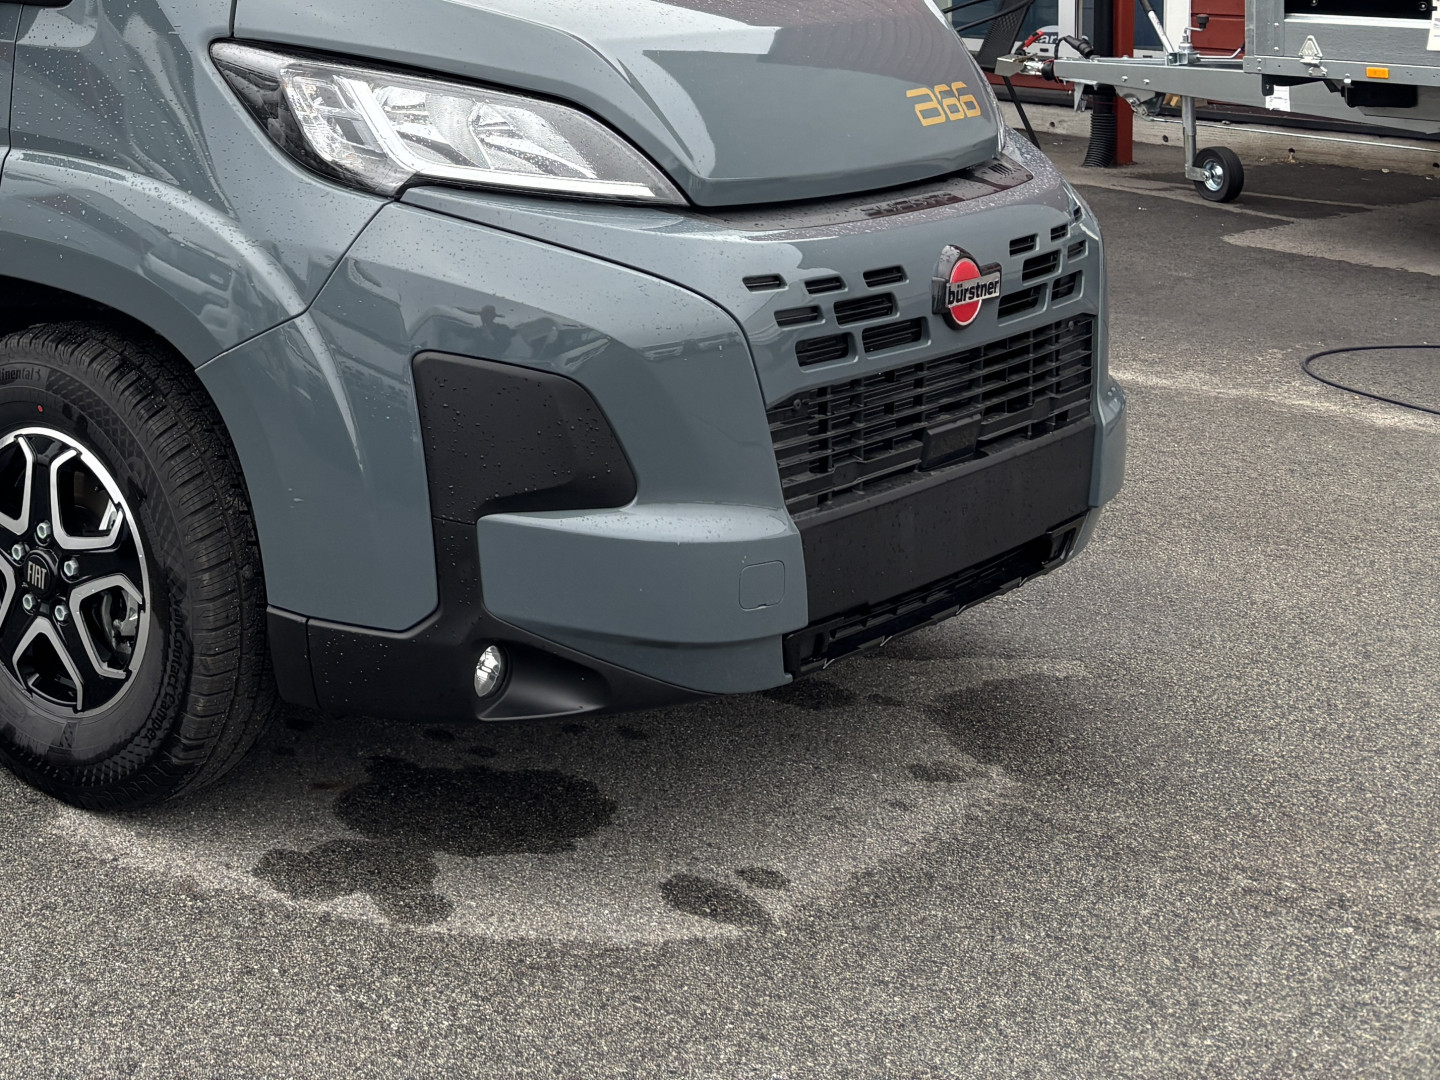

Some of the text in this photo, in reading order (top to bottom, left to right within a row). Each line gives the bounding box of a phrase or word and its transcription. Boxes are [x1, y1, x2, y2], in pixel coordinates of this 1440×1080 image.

[947, 279, 999, 305] bürstner
[27, 560, 47, 590] FIAT
[144, 693, 175, 742] Camper
